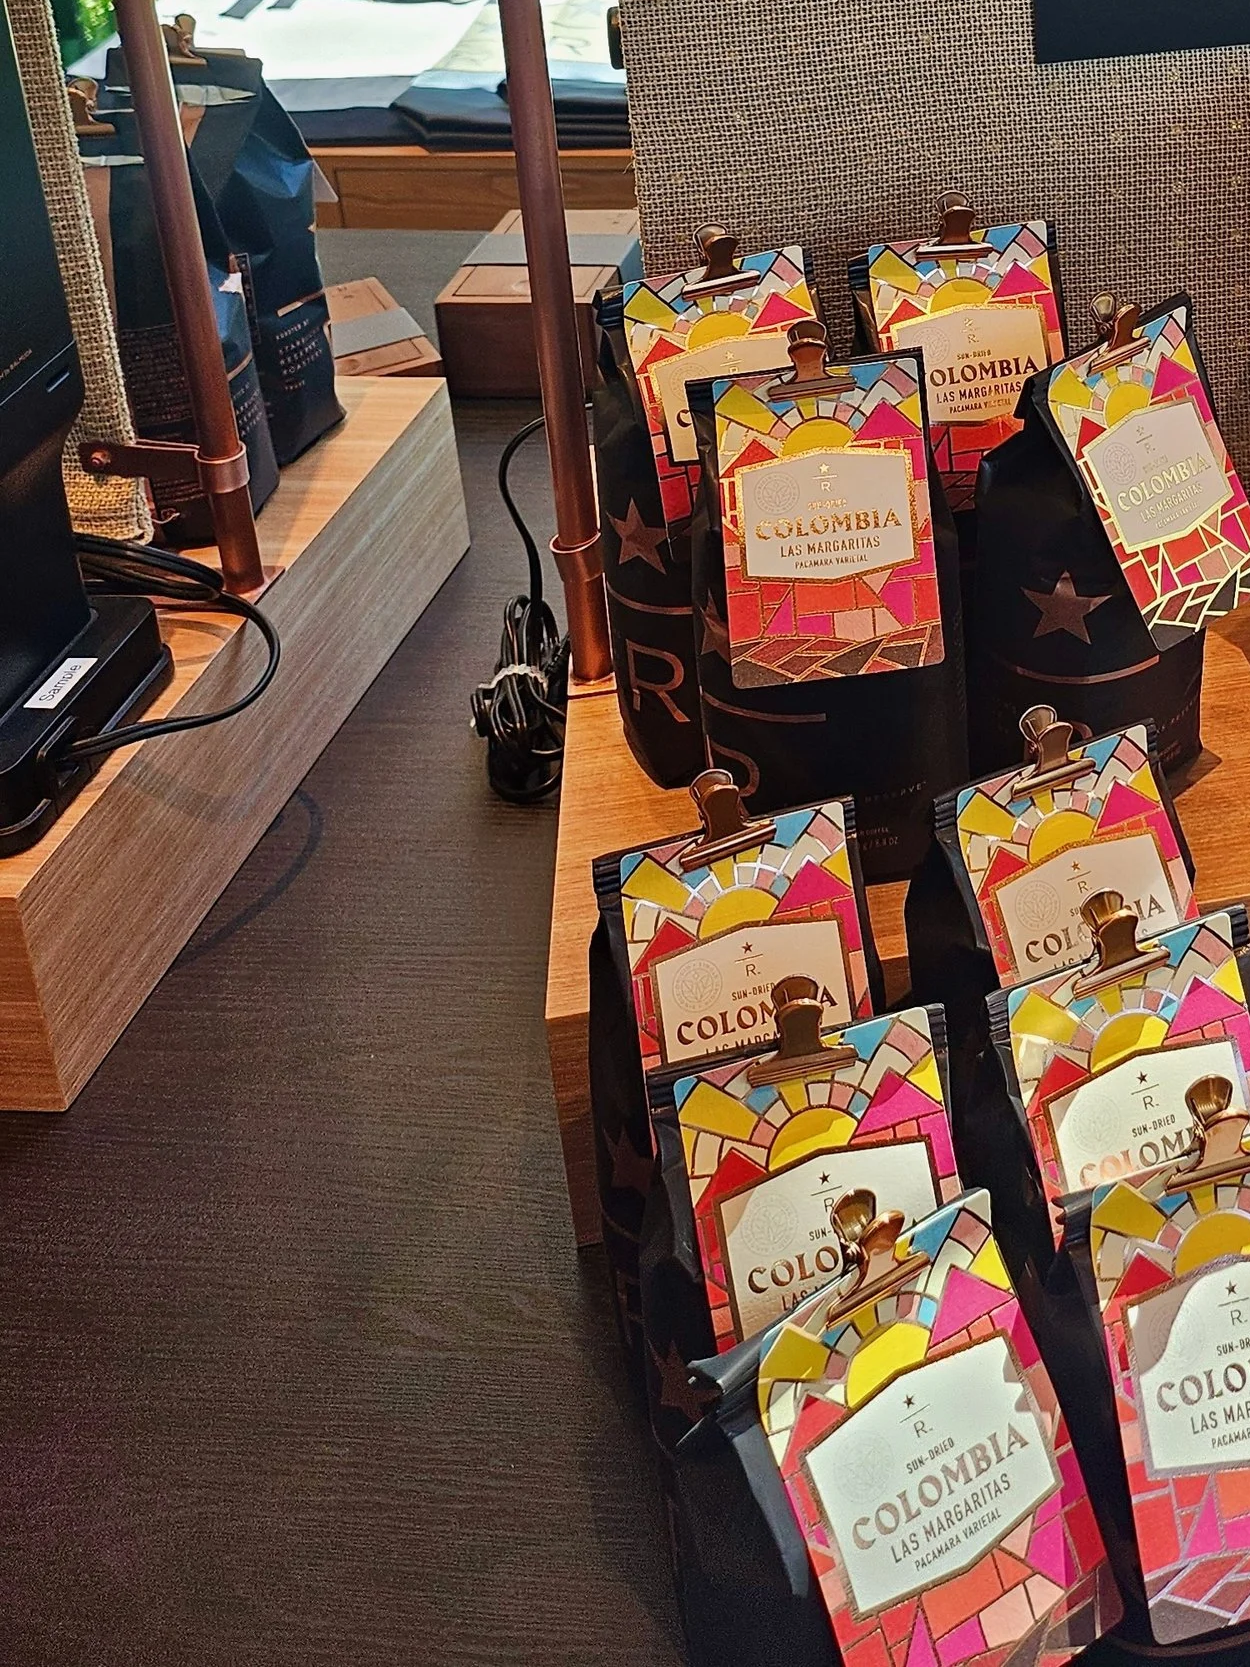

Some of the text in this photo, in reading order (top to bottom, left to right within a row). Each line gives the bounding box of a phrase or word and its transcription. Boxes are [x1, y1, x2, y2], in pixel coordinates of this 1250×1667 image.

[929, 355, 1039, 387] OLOMBIA
[936, 391, 955, 404] LAS
[1117, 452, 1211, 511] COLOMBIA
[1140, 482, 1203, 523] LAS MARGARITAS
[755, 508, 902, 540] COLOMBIA
[780, 536, 881, 558] LAS MARGARITAS
[626, 638, 691, 722] R
[677, 985, 838, 1046] COLOMA
[1132, 1114, 1176, 1138] SUN-DRIED
[1080, 1127, 1197, 1186] COLOM
[748, 1246, 839, 1294] COLO
[1190, 1410, 1218, 1435] LAS
[906, 1437, 955, 1474] SUN-DRIED
[852, 1422, 1029, 1550] COLOMBIA
[891, 1473, 1011, 1563] LAS MARGARITAS
[915, 1507, 1002, 1571] PACAMARA VARIETAL
